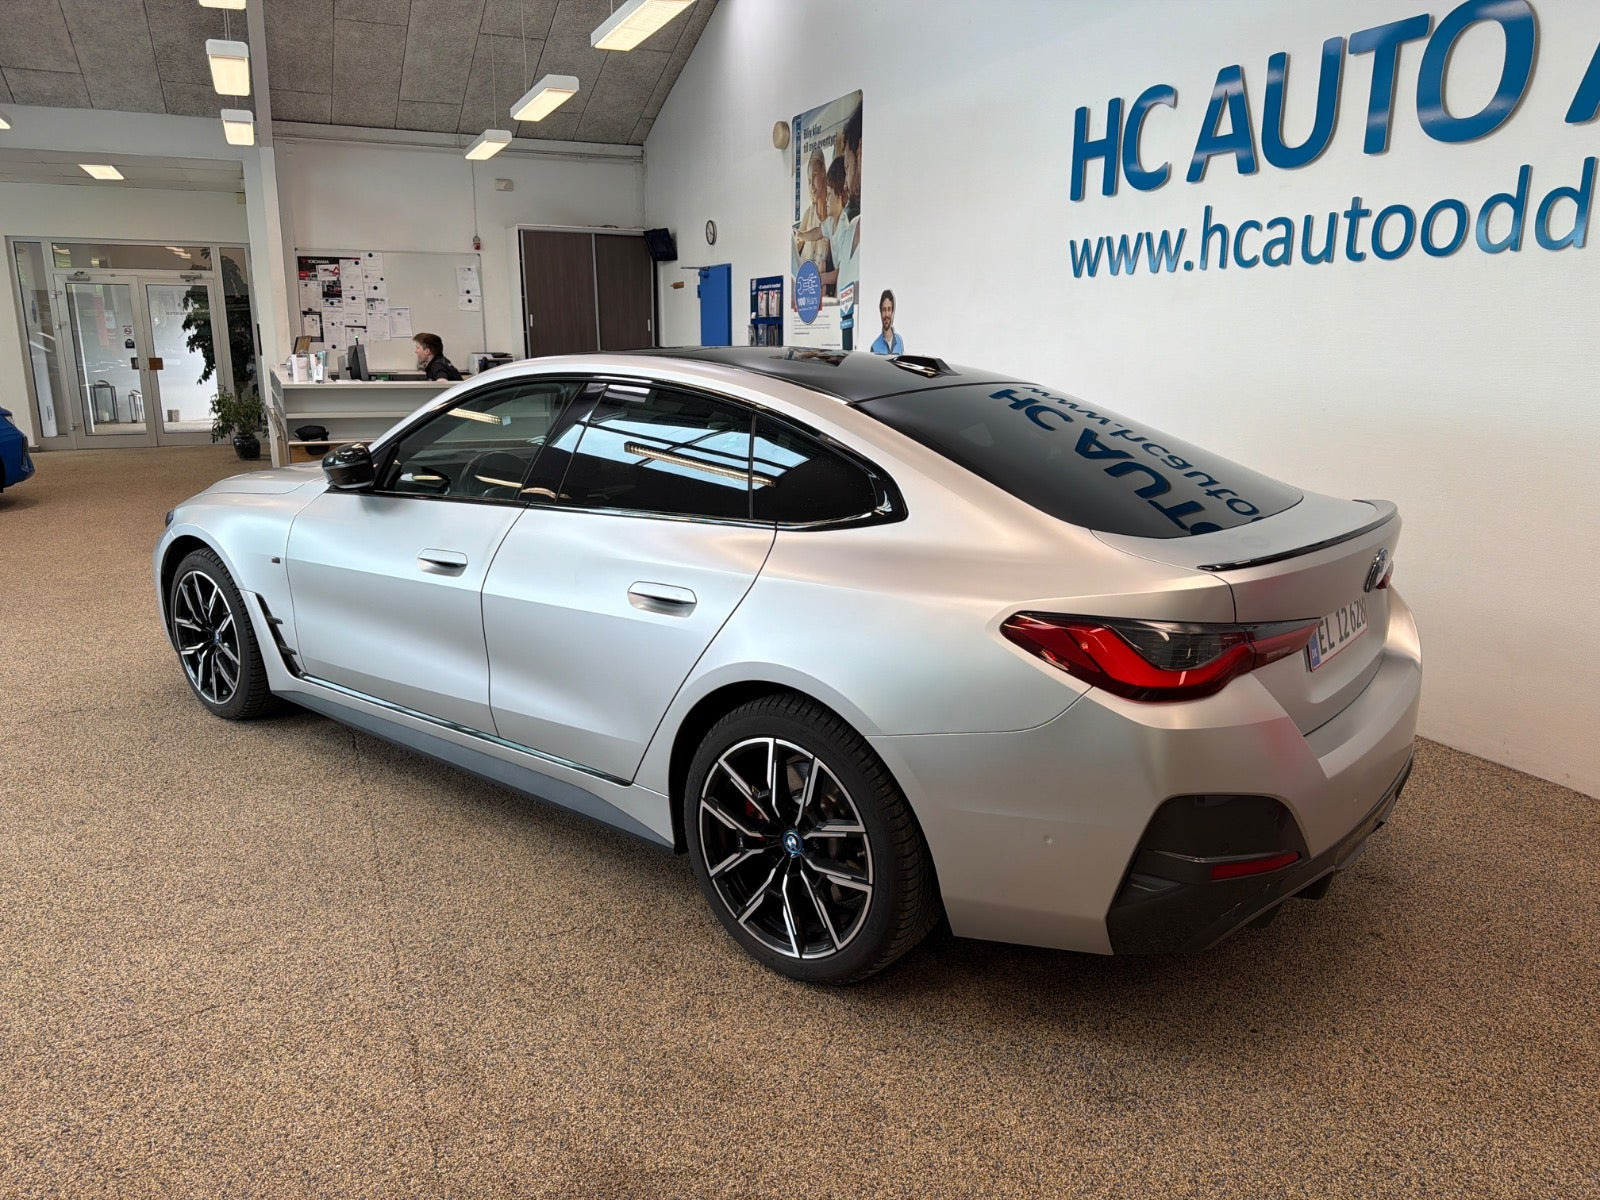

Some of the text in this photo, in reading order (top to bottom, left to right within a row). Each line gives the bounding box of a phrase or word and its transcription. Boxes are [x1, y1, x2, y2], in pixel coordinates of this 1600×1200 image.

[1069, 83, 1177, 202] HC
[1186, 0, 1537, 184] AUTO
[1069, 156, 1598, 278] www.hcautoodd
[1318, 617, 1335, 655] EL
[1336, 607, 1350, 642] 12
